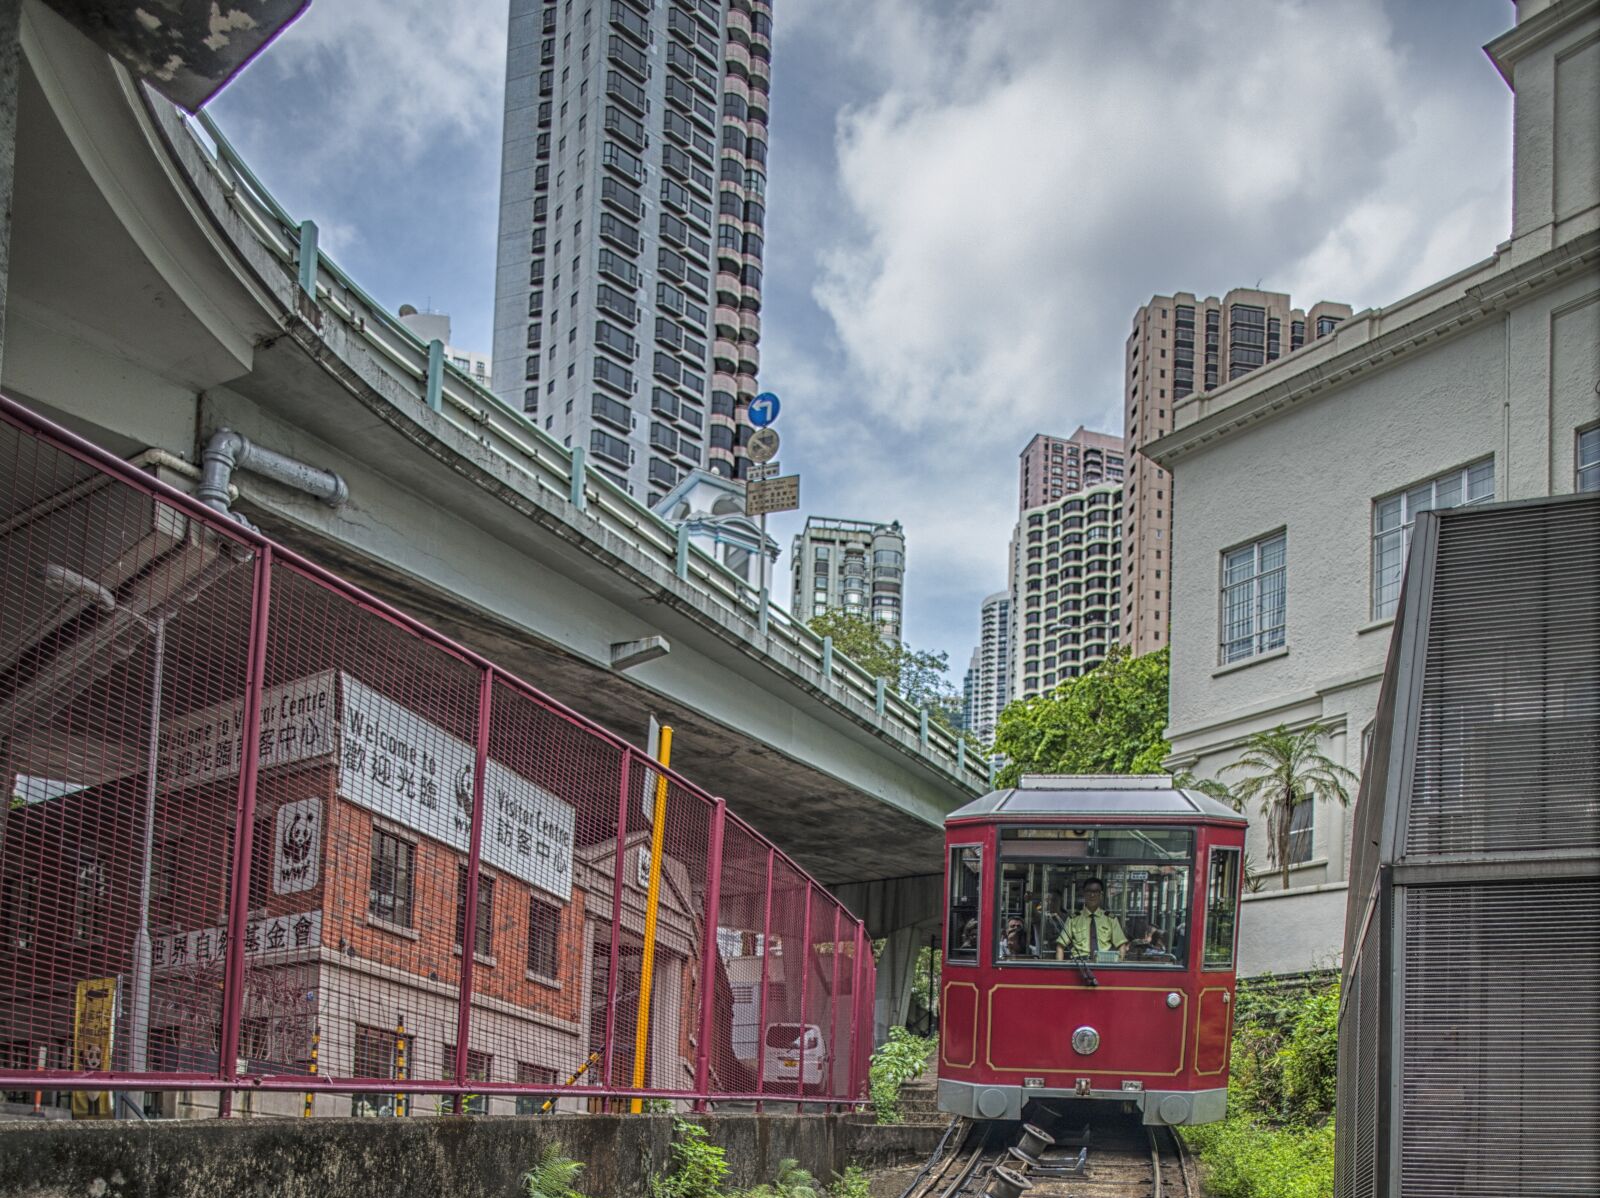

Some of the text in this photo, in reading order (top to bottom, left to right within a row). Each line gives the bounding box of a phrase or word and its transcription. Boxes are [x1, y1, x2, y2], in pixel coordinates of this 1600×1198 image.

[281, 691, 325, 719] Centre
[344, 737, 570, 874] 歡迎光臨 訪客中心
[347, 705, 570, 848] Welcome to Visitor Centre
[281, 863, 310, 882] WWF
